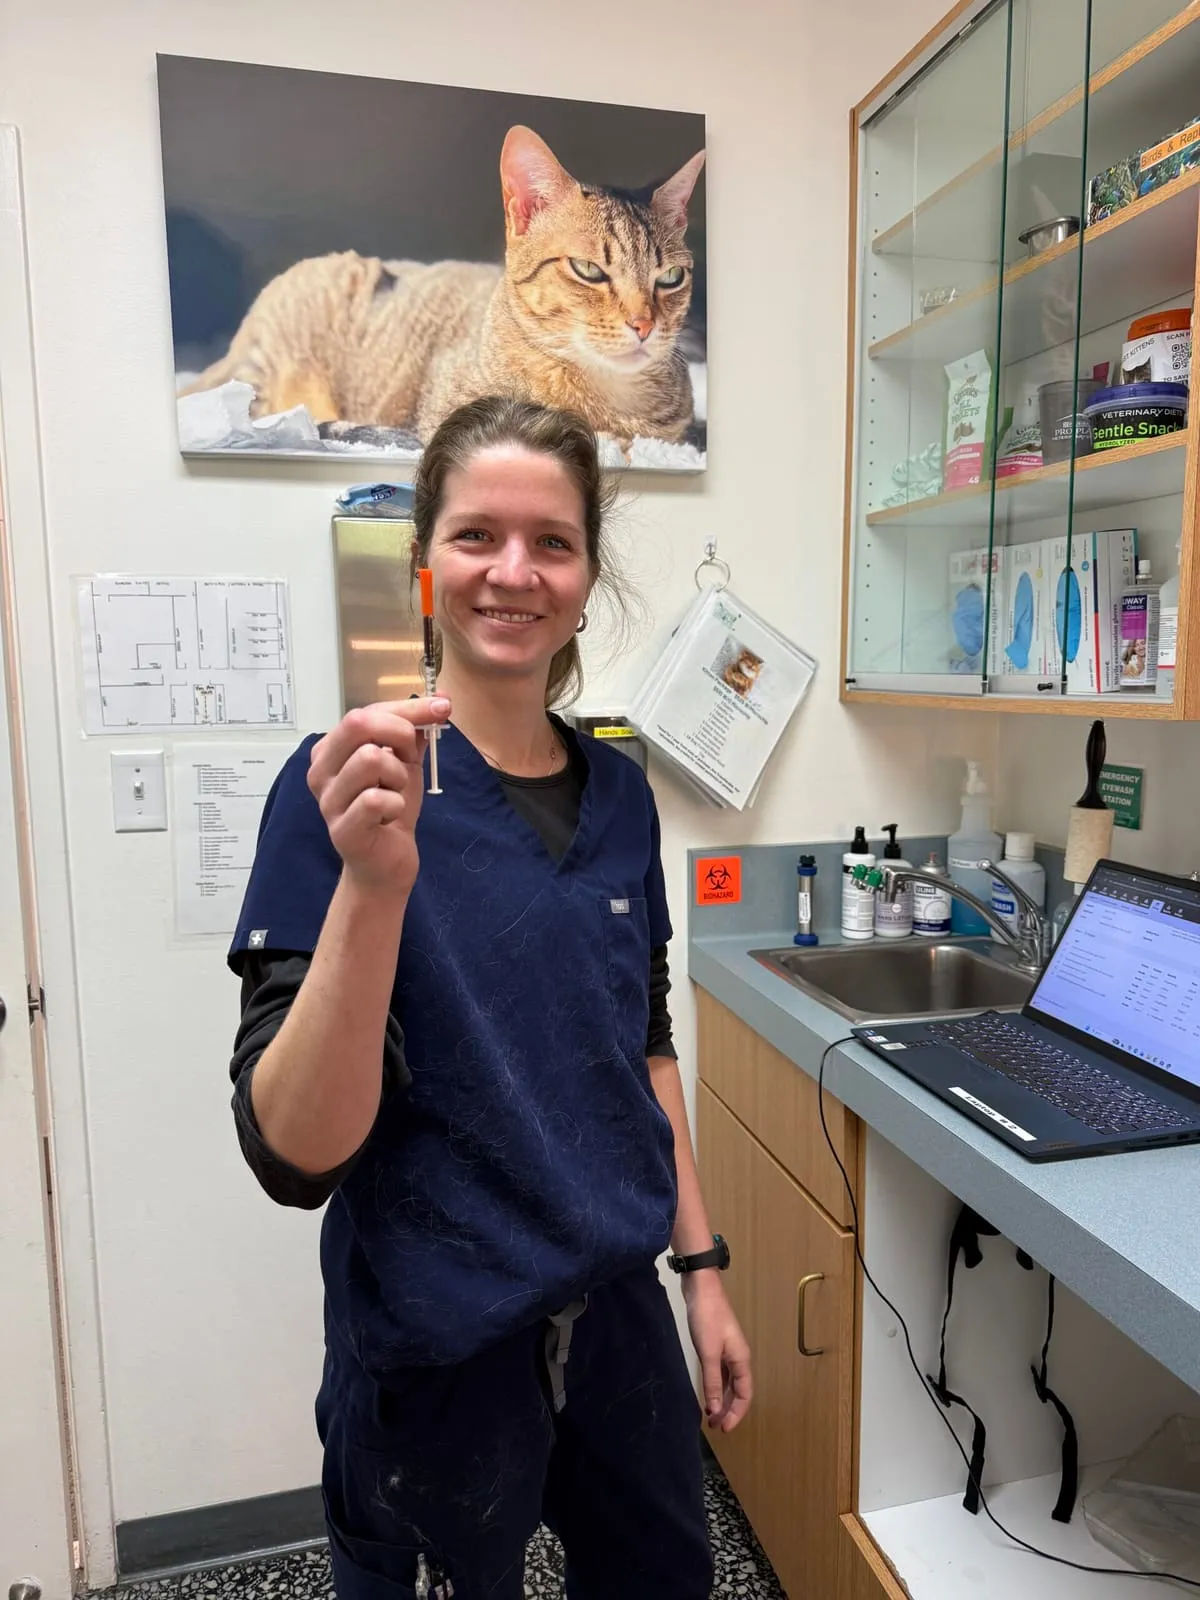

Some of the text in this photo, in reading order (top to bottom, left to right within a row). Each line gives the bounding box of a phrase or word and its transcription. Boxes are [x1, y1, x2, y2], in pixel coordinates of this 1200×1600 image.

[1167, 140, 1174, 152] &
[1166, 332, 1185, 341] SCAN
[1130, 337, 1155, 356] KITTENS
[1102, 408, 1163, 419] VETERINARY
[1092, 423, 1134, 440] Gentle
[1112, 624, 1120, 664] examination
[1101, 783, 1135, 795] EYEWASH
[1103, 794, 1132, 807] STATION
[703, 891, 734, 900] BIOHAZARD
[965, 1096, 996, 1117] Laptop
